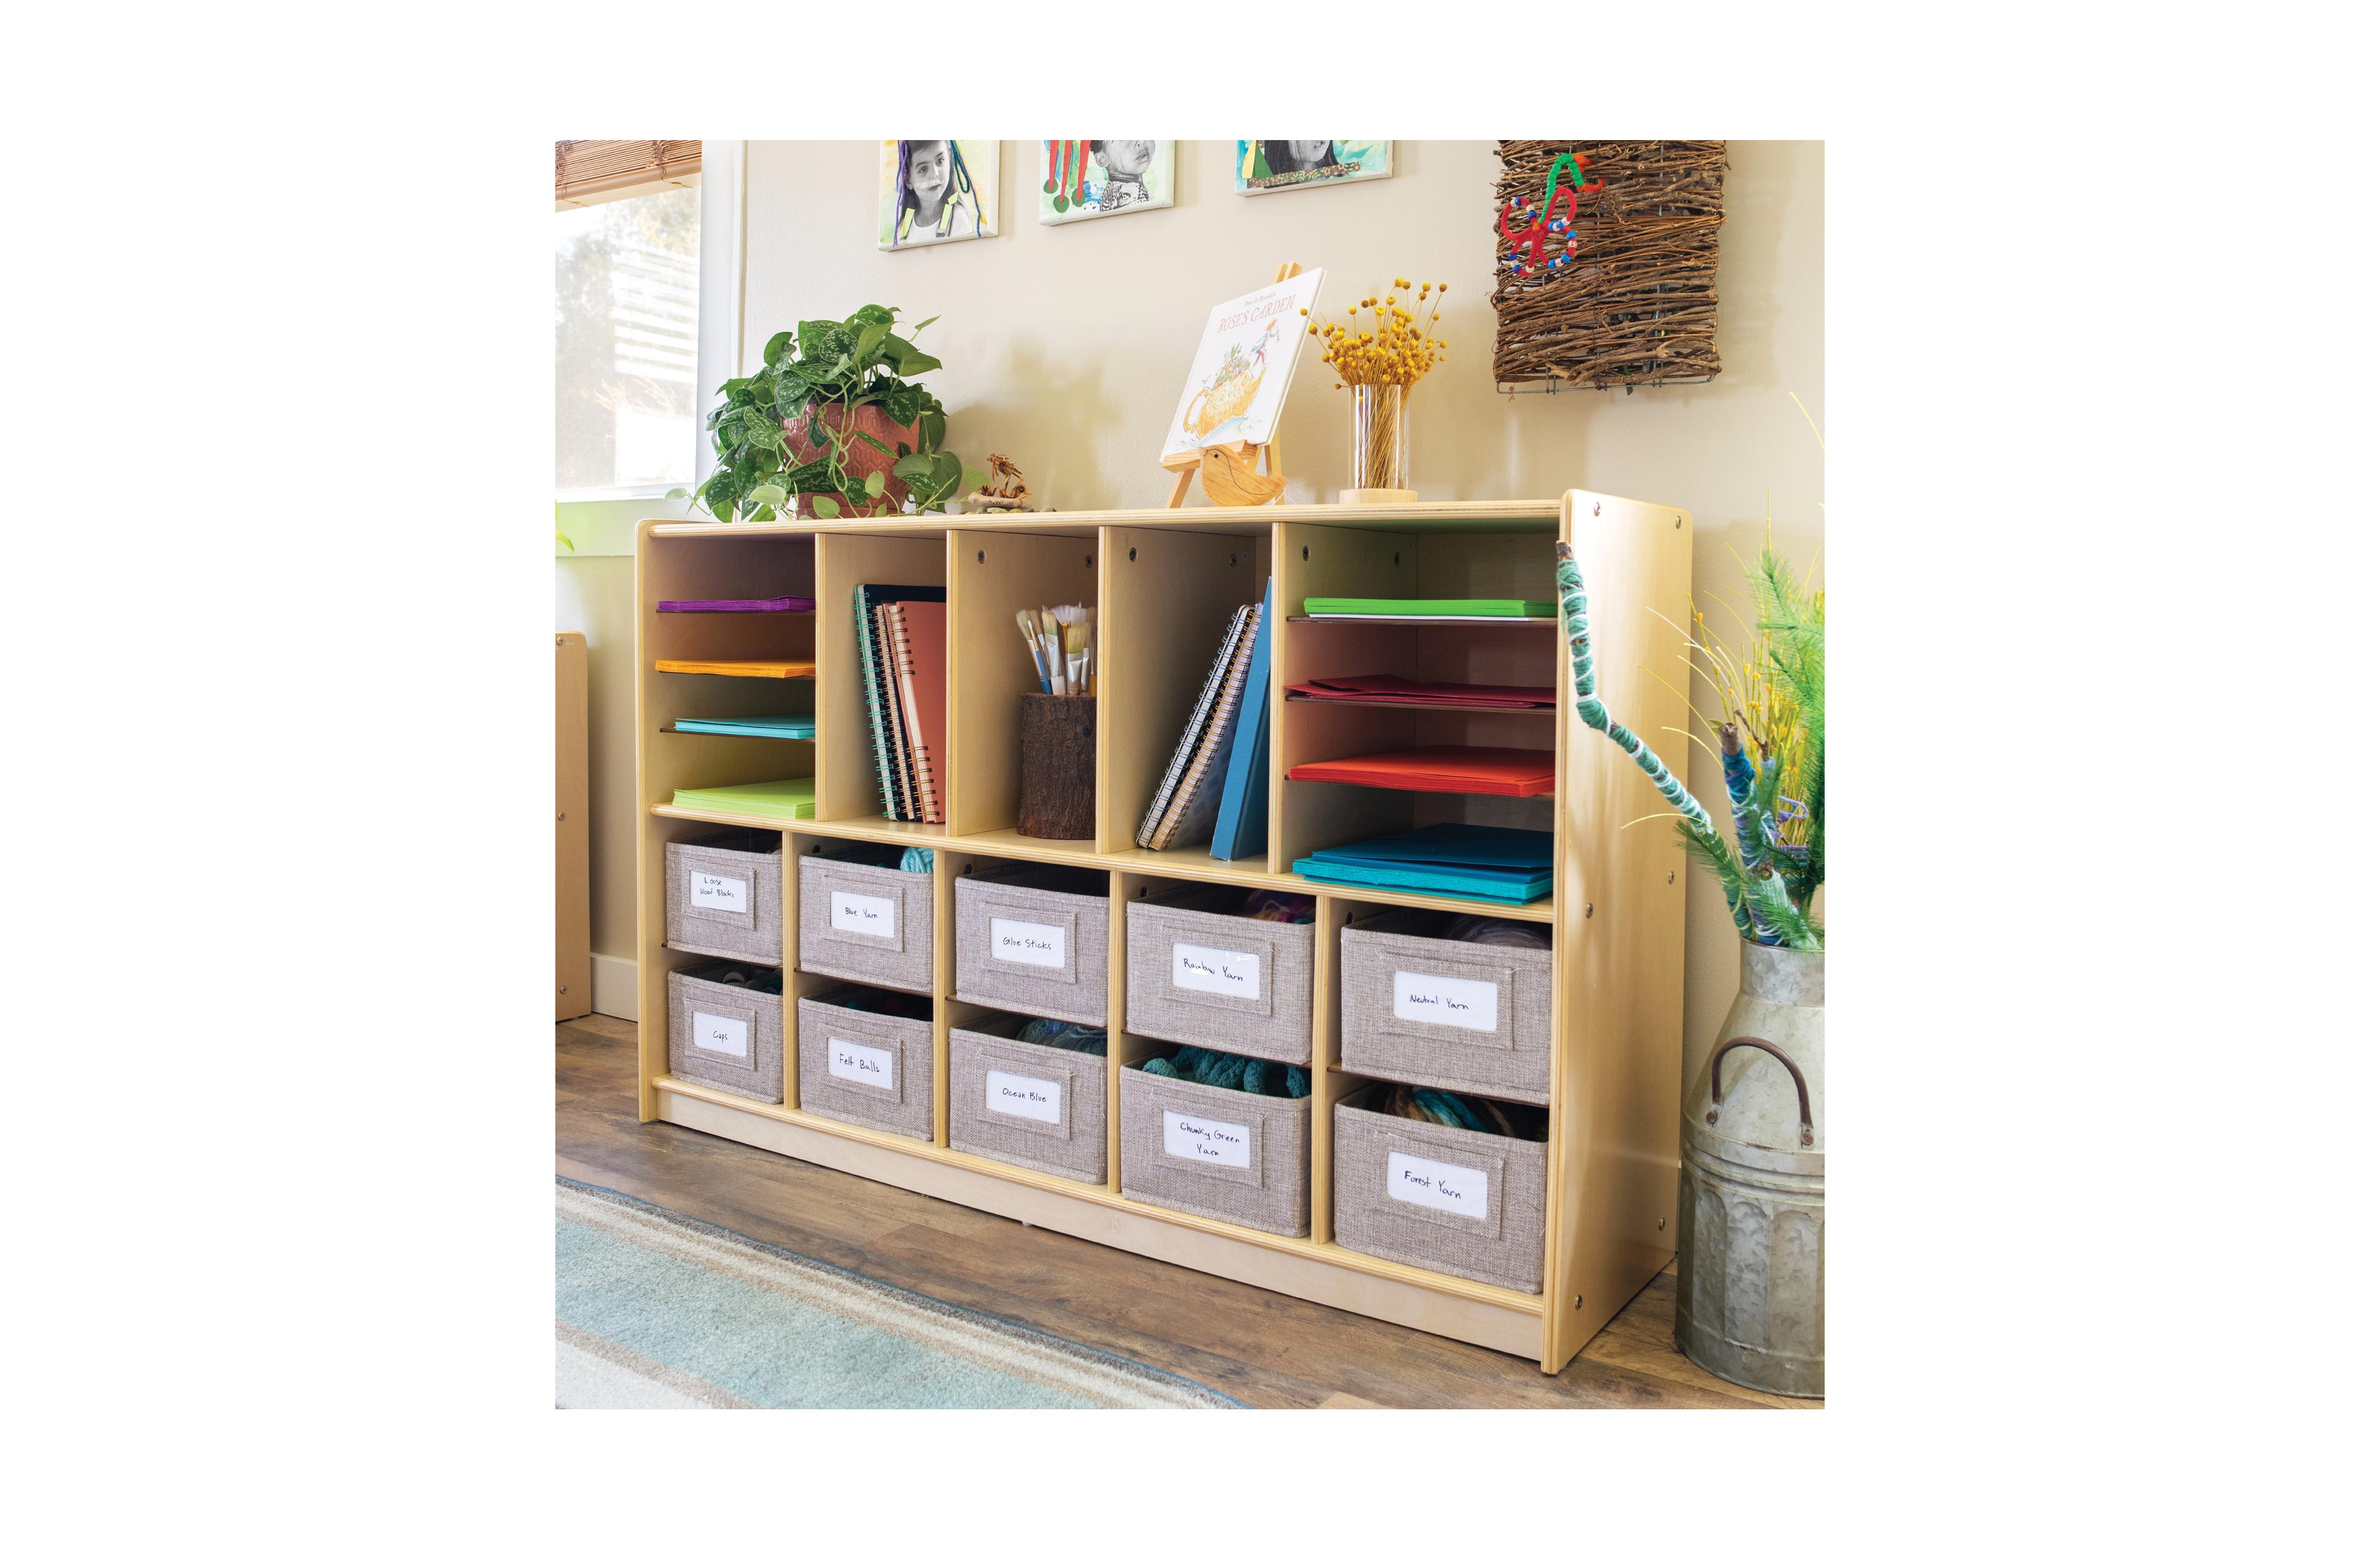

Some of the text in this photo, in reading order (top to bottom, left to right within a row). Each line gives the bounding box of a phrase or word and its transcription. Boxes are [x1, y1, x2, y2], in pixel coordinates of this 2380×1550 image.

[1251, 294, 1297, 322] GARDEN
[700, 887, 734, 897] Wood Blocks
[845, 907, 878, 918] Blue Yarn
[1003, 936, 1052, 950] Glue Sticks
[1183, 958, 1243, 982] Rainbow Yarn
[1409, 994, 1469, 1010] Neutral Yarn
[713, 1030, 728, 1044] Caps
[839, 1052, 880, 1073] Felt Balls
[1002, 1087, 1047, 1103] Ocean Blue
[1179, 1122, 1240, 1143] Chunky Green
[1196, 1143, 1219, 1156] Yarn
[1404, 1170, 1461, 1199] Forest Yarn
